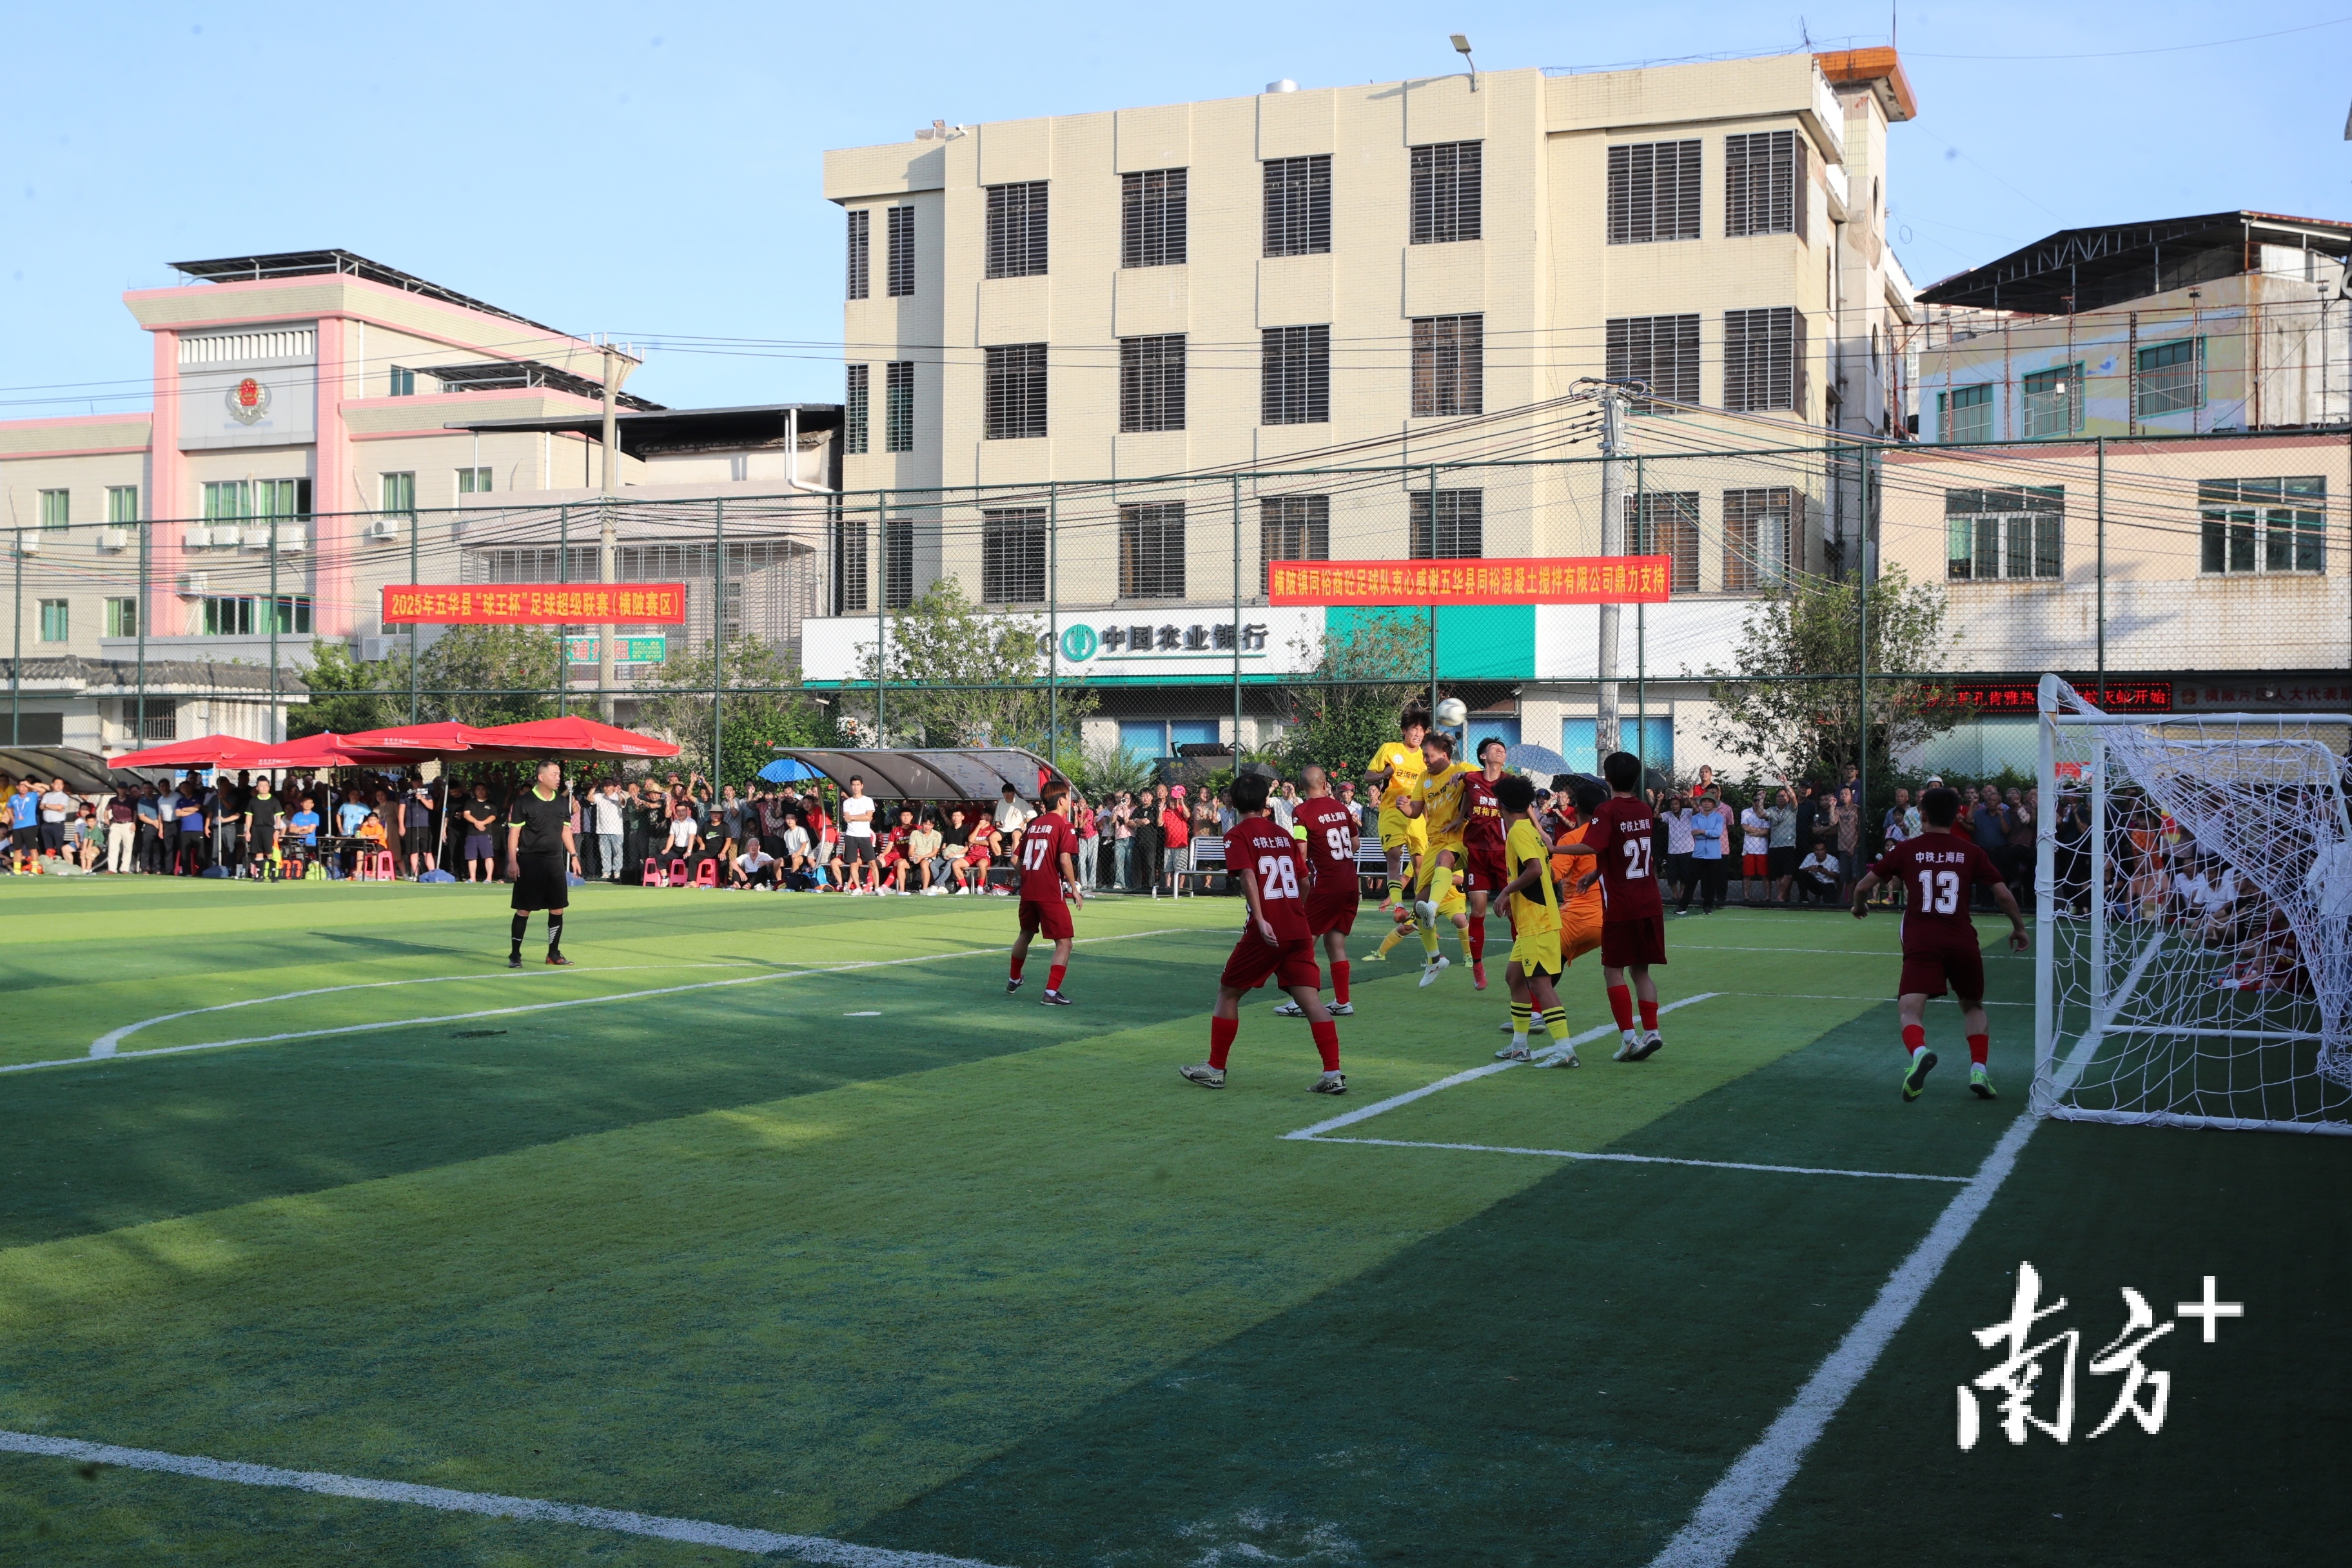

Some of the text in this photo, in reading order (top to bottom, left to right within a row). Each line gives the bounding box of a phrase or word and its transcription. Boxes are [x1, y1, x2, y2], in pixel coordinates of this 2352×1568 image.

[1274, 564, 1665, 596] 横陂镇同裕商砼足球队衷心感谢五华县同裕混凝土搅拌有限公司鼎力支持
[1102, 623, 1269, 652] 中国农业银行
[1318, 812, 1347, 824] 中铁上海局
[1620, 819, 1651, 832] 中铁上海局
[1023, 839, 1048, 870] 47
[1253, 836, 1290, 848] 中铁上海局
[1326, 826, 1353, 860] 99
[1916, 852, 1965, 863] 中铁上海局
[1623, 837, 1651, 879] 27
[1258, 856, 1299, 900] 28
[1919, 870, 1959, 914] 13
